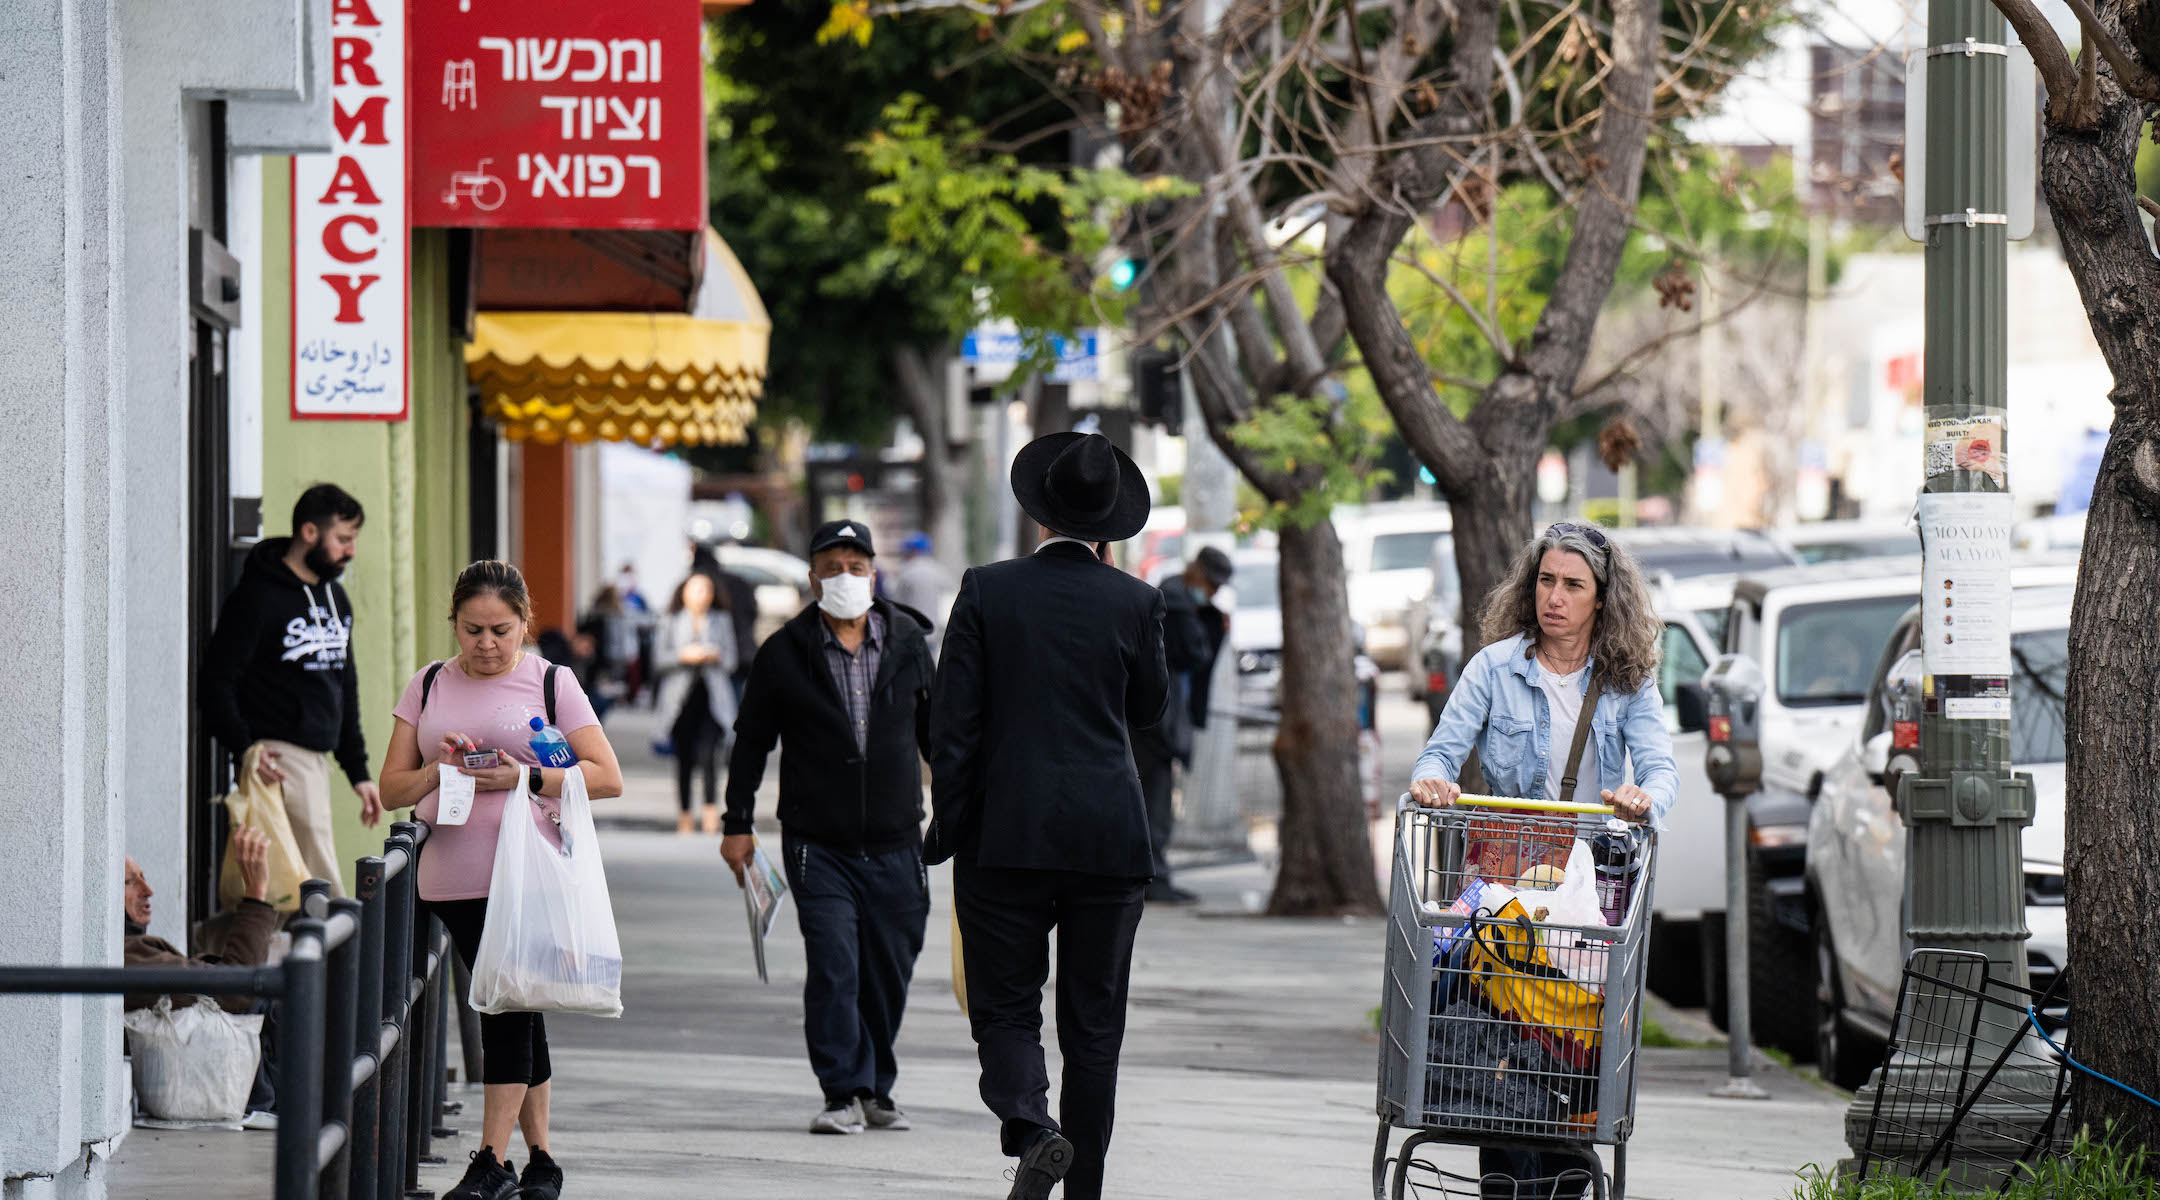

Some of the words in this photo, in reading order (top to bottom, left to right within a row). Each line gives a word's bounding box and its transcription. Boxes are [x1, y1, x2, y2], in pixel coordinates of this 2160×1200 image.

[478, 37, 662, 83] ומכשור
[541, 96, 662, 140] וציוד
[518, 154, 662, 198] רפואי
[1963, 417, 1992, 426] UKKAH
[1935, 526, 2006, 539] MONDAYS
[549, 747, 571, 767] FIJI
